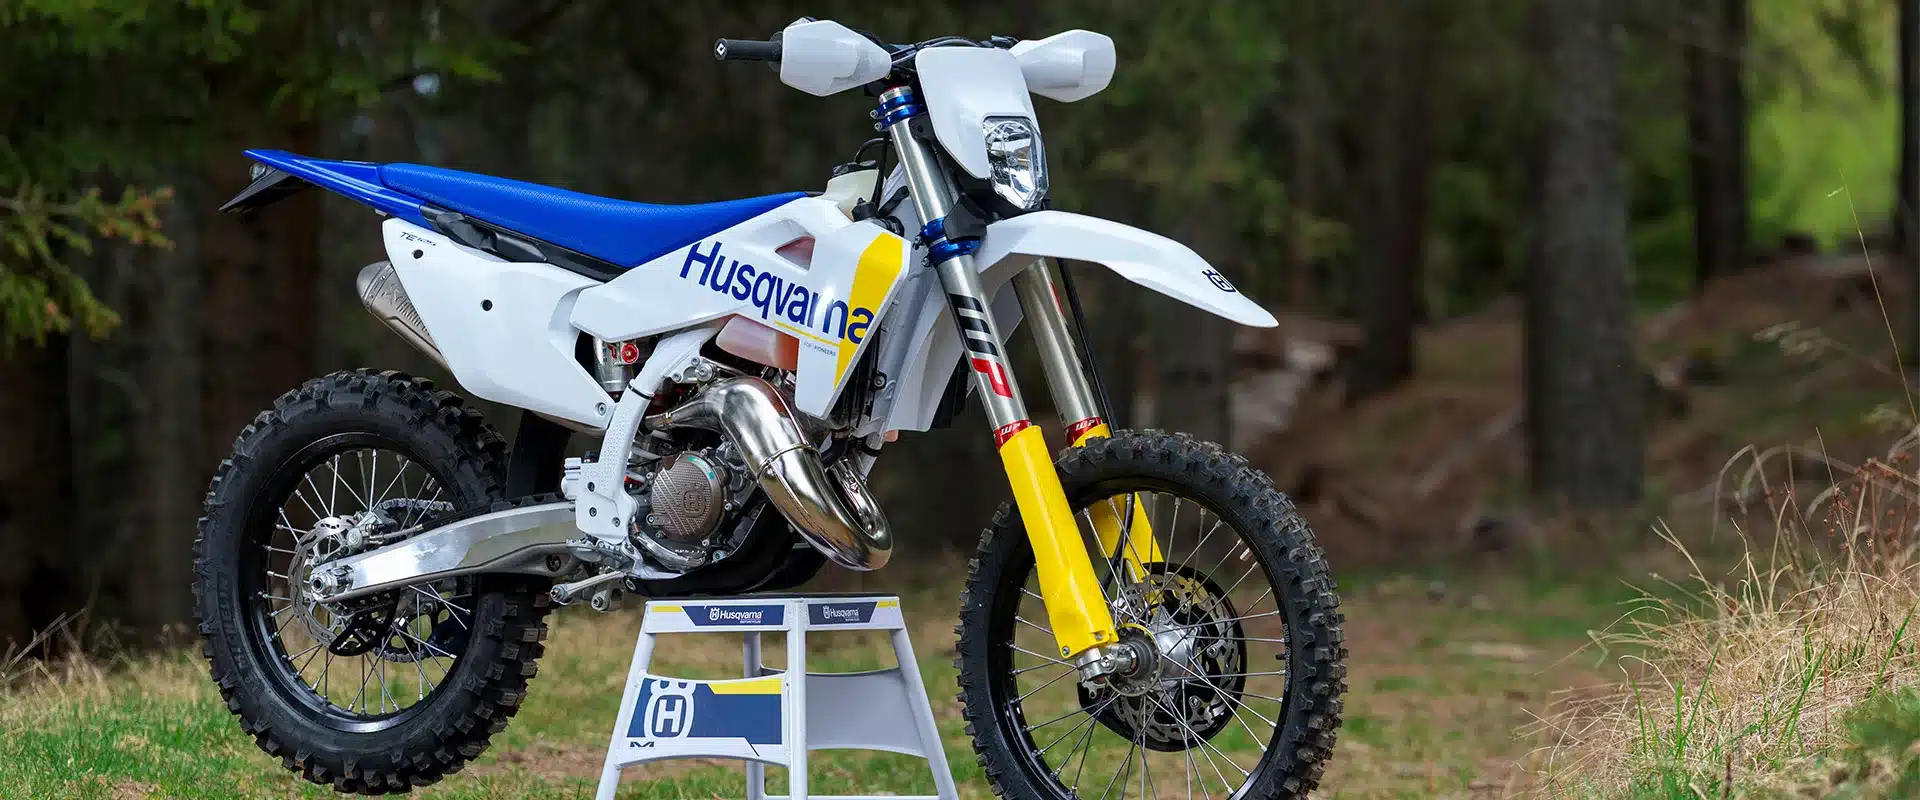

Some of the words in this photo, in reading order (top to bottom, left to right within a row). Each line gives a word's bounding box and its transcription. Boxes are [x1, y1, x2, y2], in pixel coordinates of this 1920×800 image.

[400, 231, 418, 242] TE
[679, 241, 875, 344] Husqvarna
[948, 293, 1014, 399] WP
[1000, 422, 1021, 436] WP
[1075, 419, 1096, 432] WP
[719, 610, 762, 621] Husqvarna
[829, 608, 860, 619] Husqvarna
